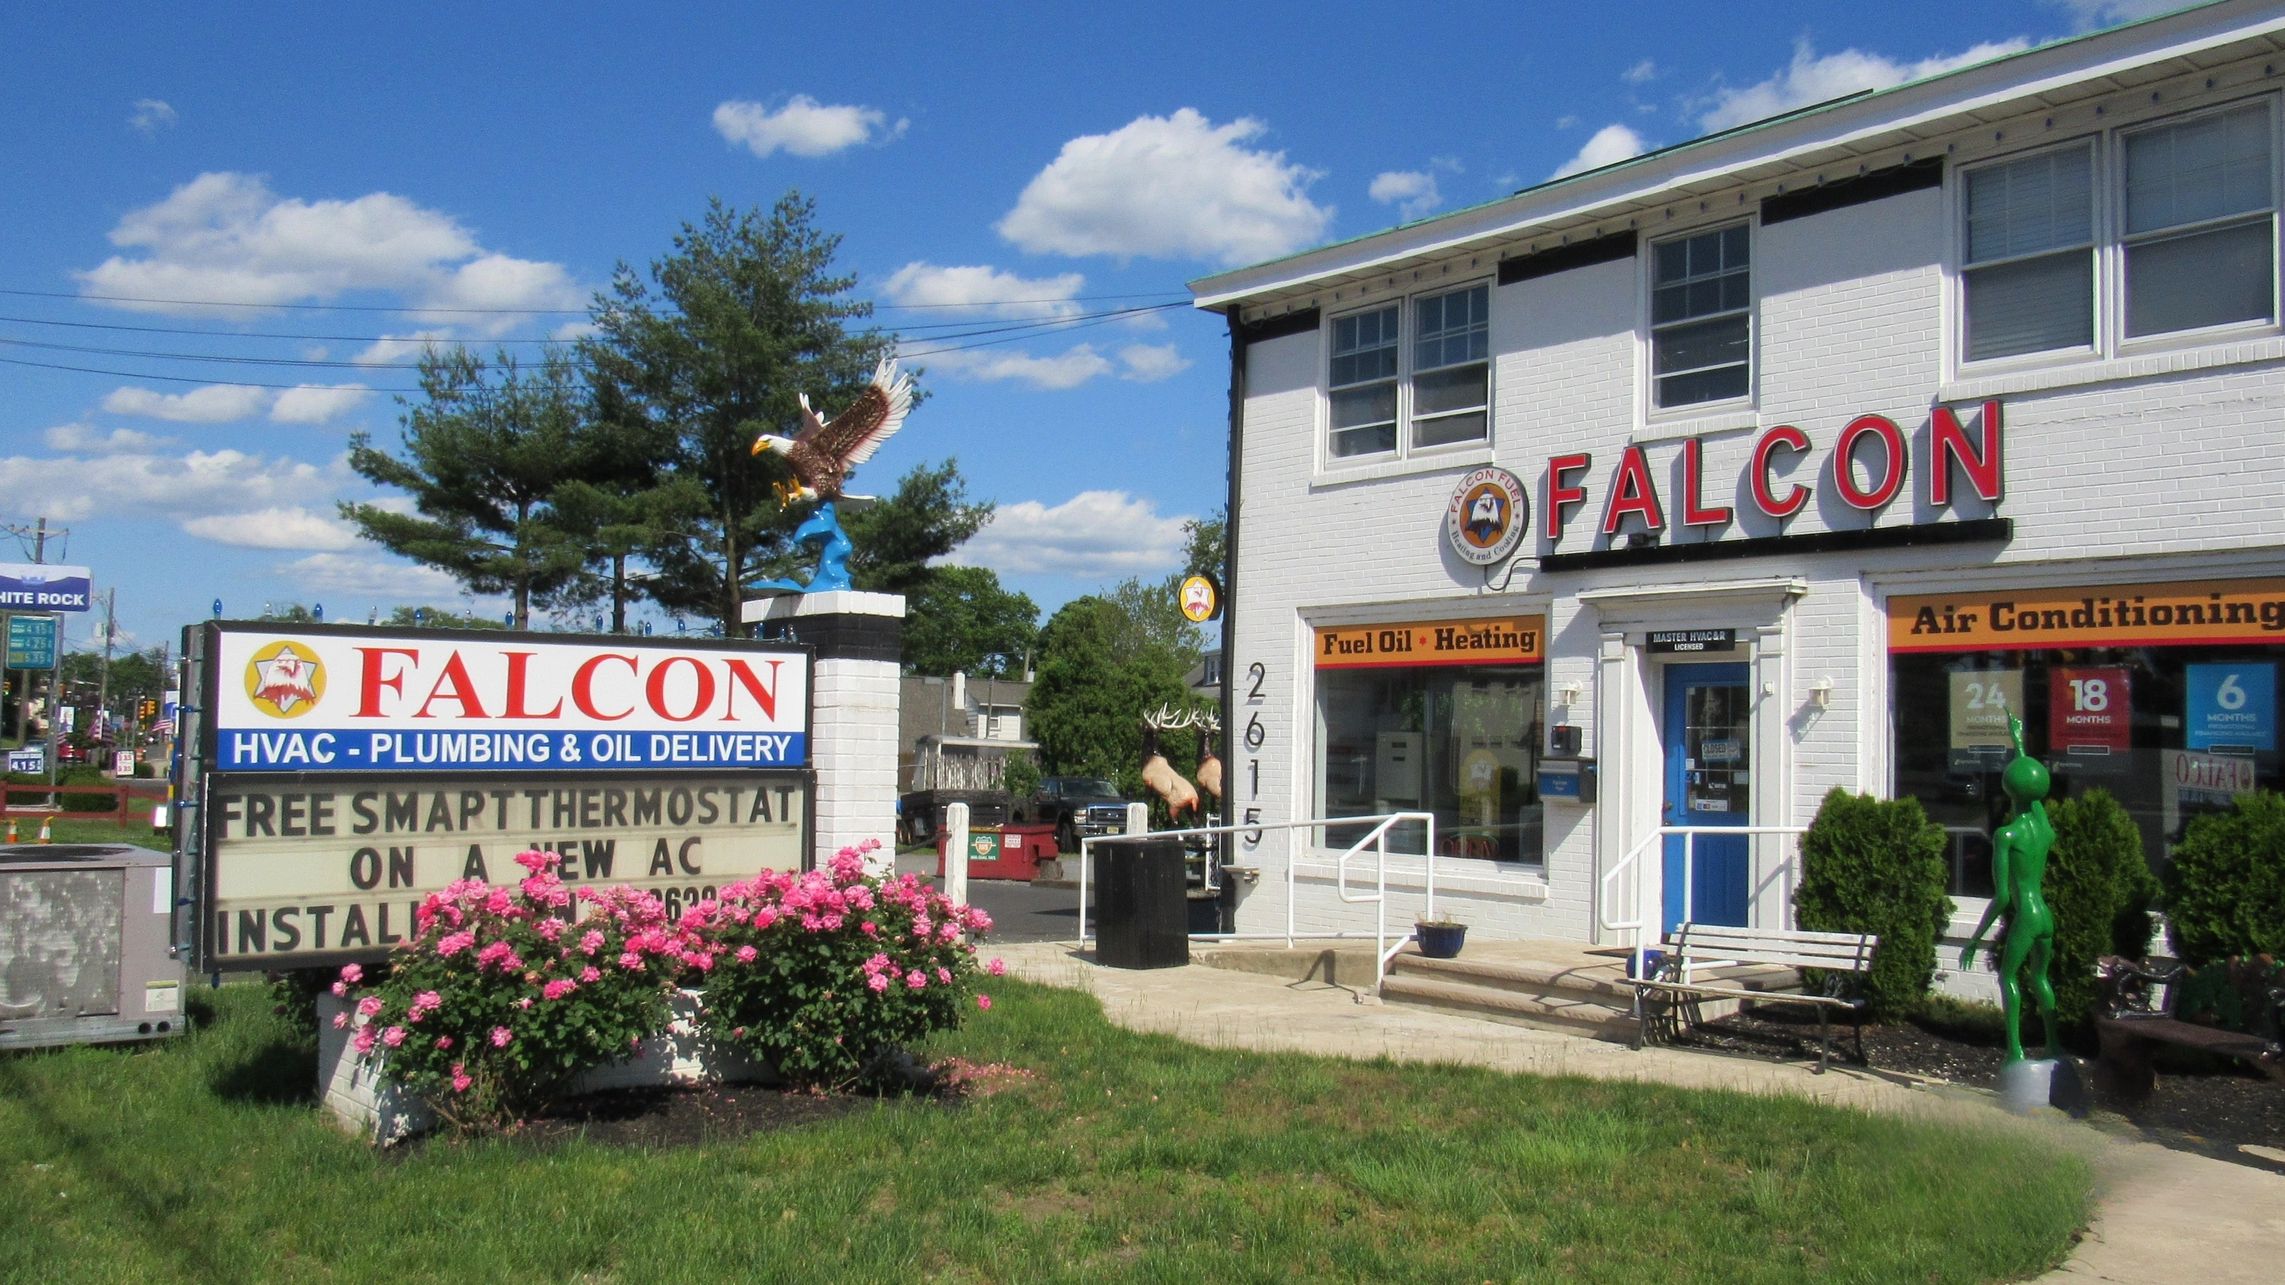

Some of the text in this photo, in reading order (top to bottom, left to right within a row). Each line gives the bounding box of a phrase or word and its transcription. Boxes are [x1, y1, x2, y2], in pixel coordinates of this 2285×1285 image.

[1547, 400, 2004, 540] FALCON
[1451, 470, 1521, 513] FALCON FUEL
[38, 593, 85, 606] ROCK
[1911, 593, 2285, 635] Air Conditioning
[1323, 625, 1536, 655] Fuel Oil Heating
[1653, 632, 1687, 643] MASTER
[1674, 643, 1704, 651] LICENSED
[348, 646, 785, 722] FALCON
[1965, 682, 2006, 709] 24
[2069, 679, 2108, 712] 18
[2216, 674, 2246, 710] 6
[2066, 715, 2111, 724] MONTHS
[2207, 713, 2257, 722] MONTHS
[233, 732, 336, 764] HVAC
[370, 733, 550, 764] PLUMBING
[560, 734, 582, 762] &
[591, 733, 641, 762] OIL
[650, 735, 792, 762] DELIVERY
[218, 793, 336, 838] FREE
[525, 786, 795, 829] THERMOSTAT
[350, 847, 414, 890] ON
[463, 843, 490, 883] A
[649, 836, 702, 876] AC
